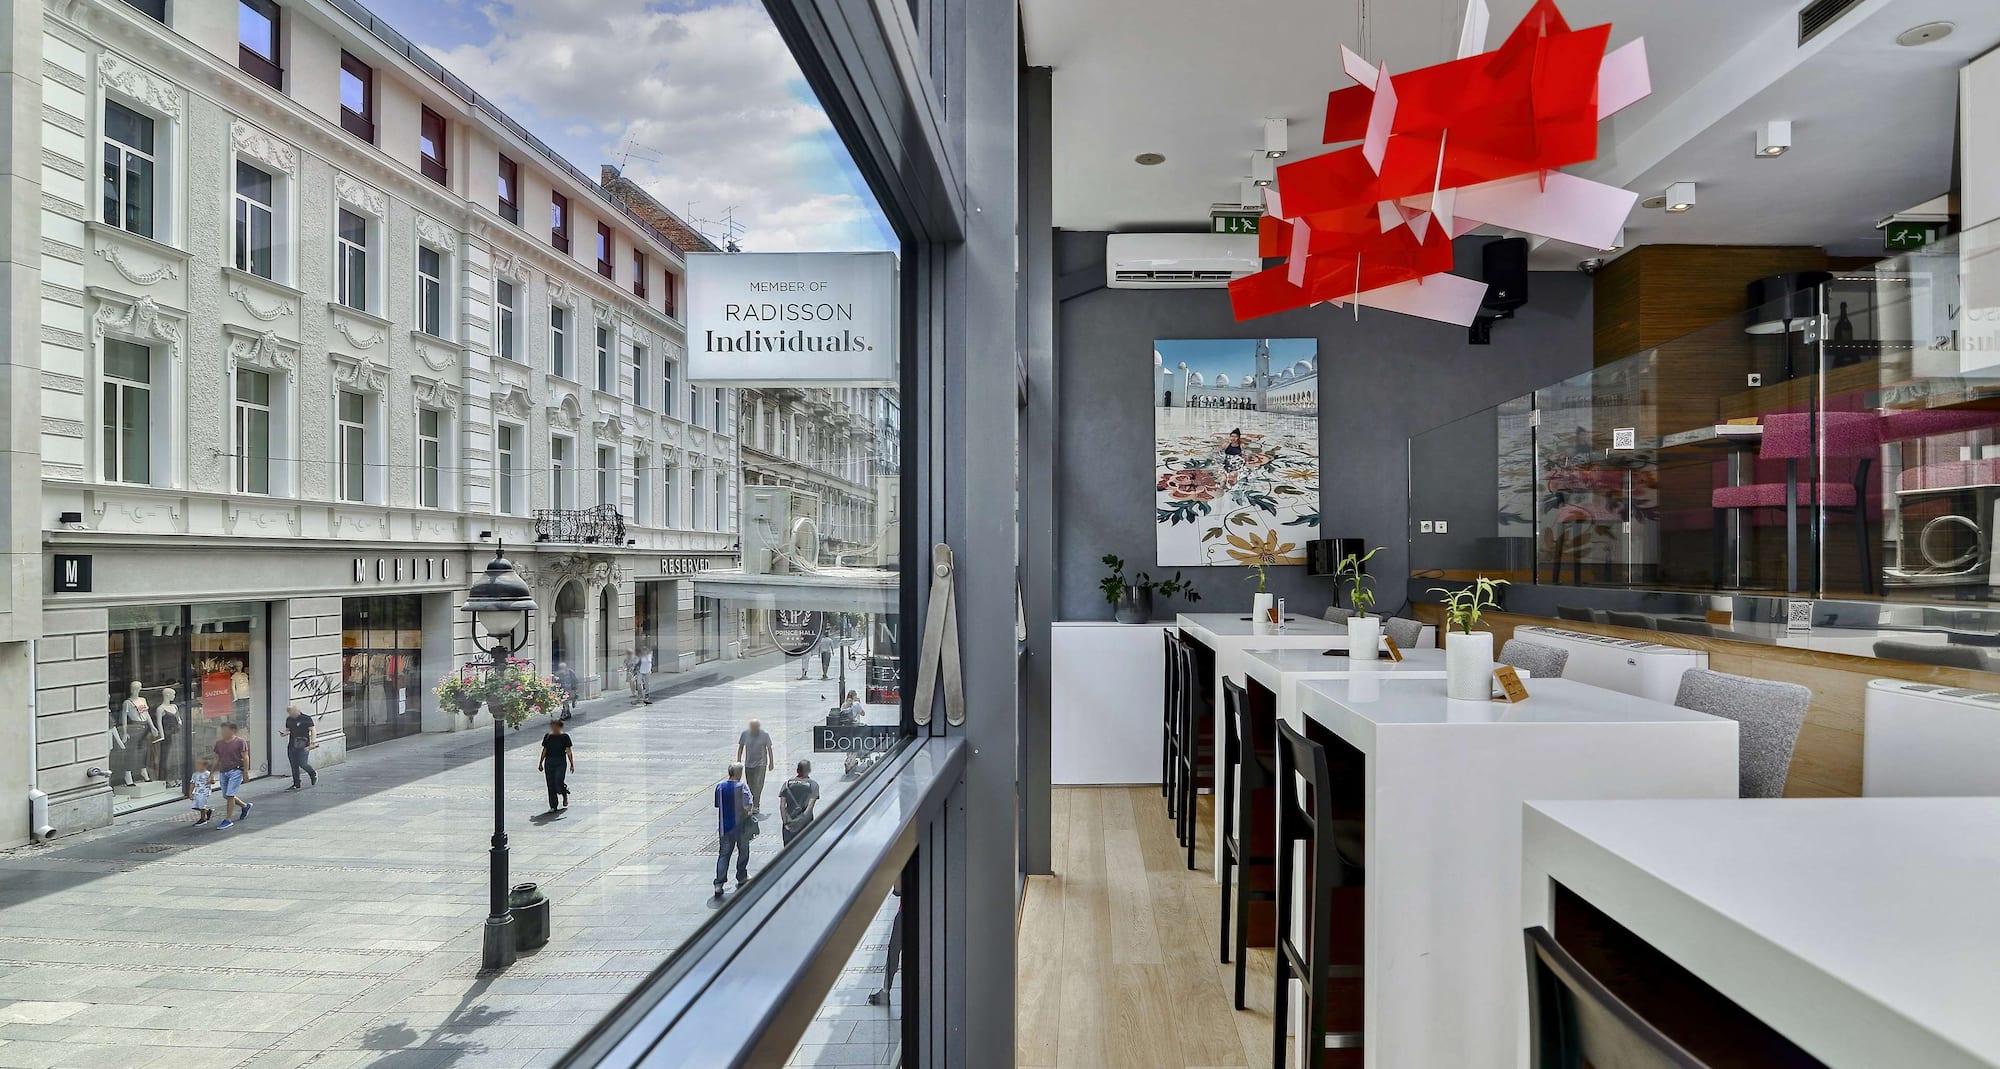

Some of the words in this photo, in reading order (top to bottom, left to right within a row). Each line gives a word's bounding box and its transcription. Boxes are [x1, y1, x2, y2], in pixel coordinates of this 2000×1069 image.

[750, 282, 805, 292] MEMBER
[809, 282, 828, 292] OF
[726, 303, 852, 321] RADISSON
[705, 330, 873, 353] Individuals.
[66, 560, 78, 586] M
[354, 558, 450, 582] MOHITO
[661, 558, 710, 574] RESERVED
[823, 729, 896, 751] Bonatti
